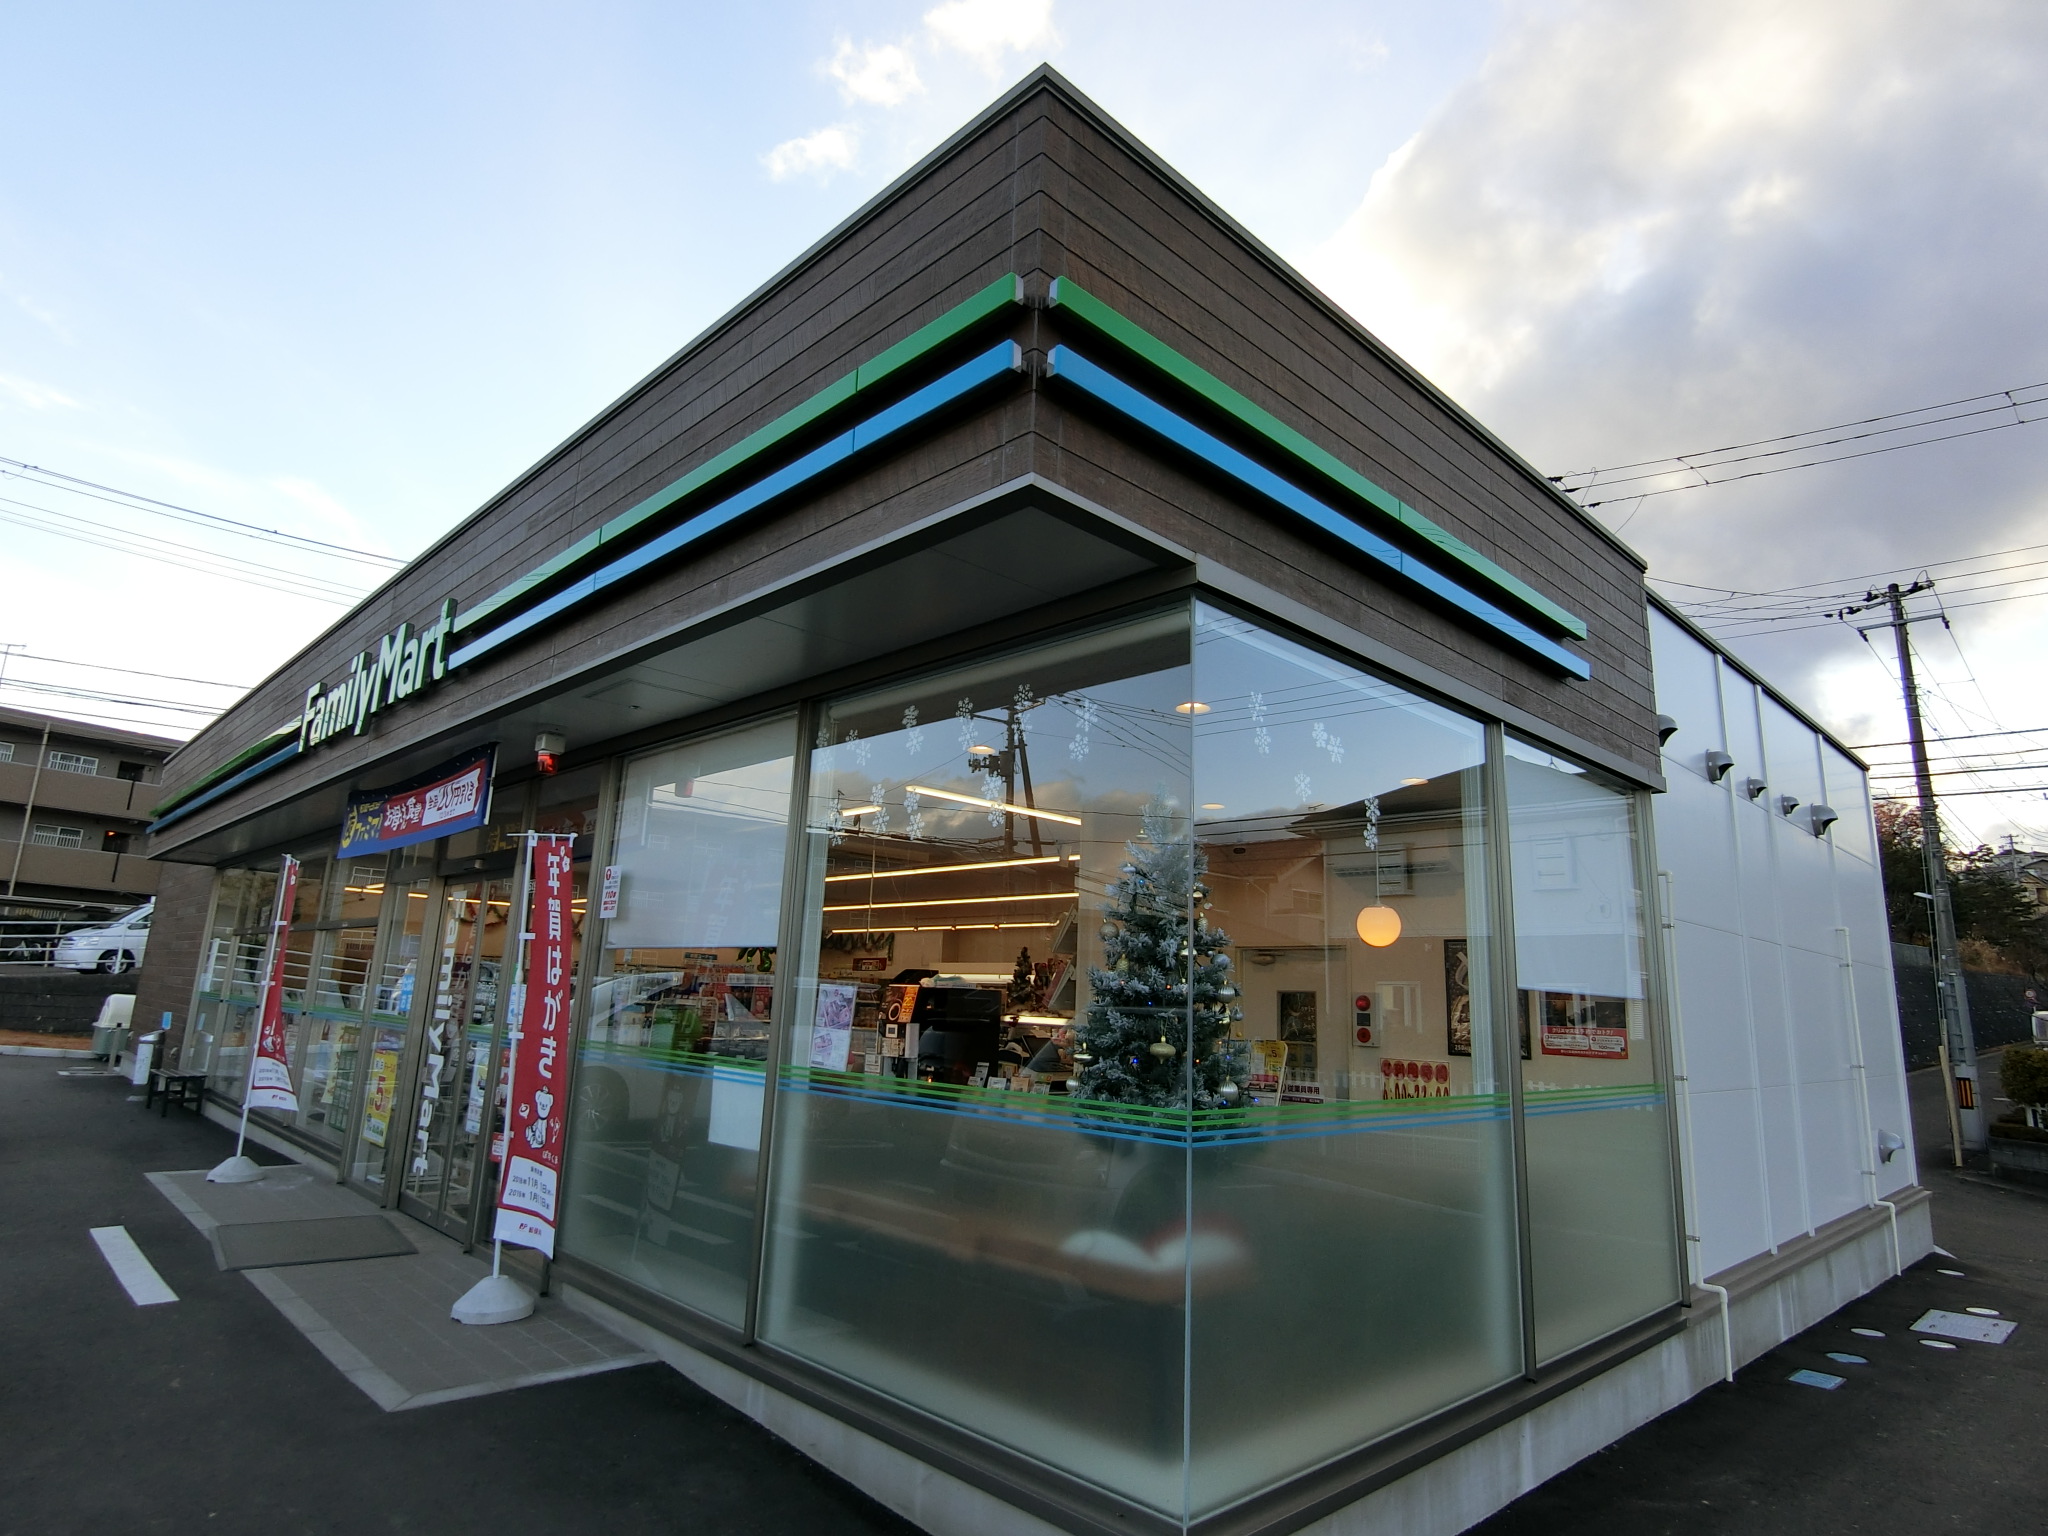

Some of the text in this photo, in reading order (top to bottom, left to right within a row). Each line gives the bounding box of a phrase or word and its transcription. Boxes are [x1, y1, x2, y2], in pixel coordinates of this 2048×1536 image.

[297, 597, 457, 754] FamilyMart
[413, 889, 467, 1177] FamilyMart
[538, 852, 564, 1079] 年賀はがき
[1287, 1084, 1320, 1095] 従業員専用
